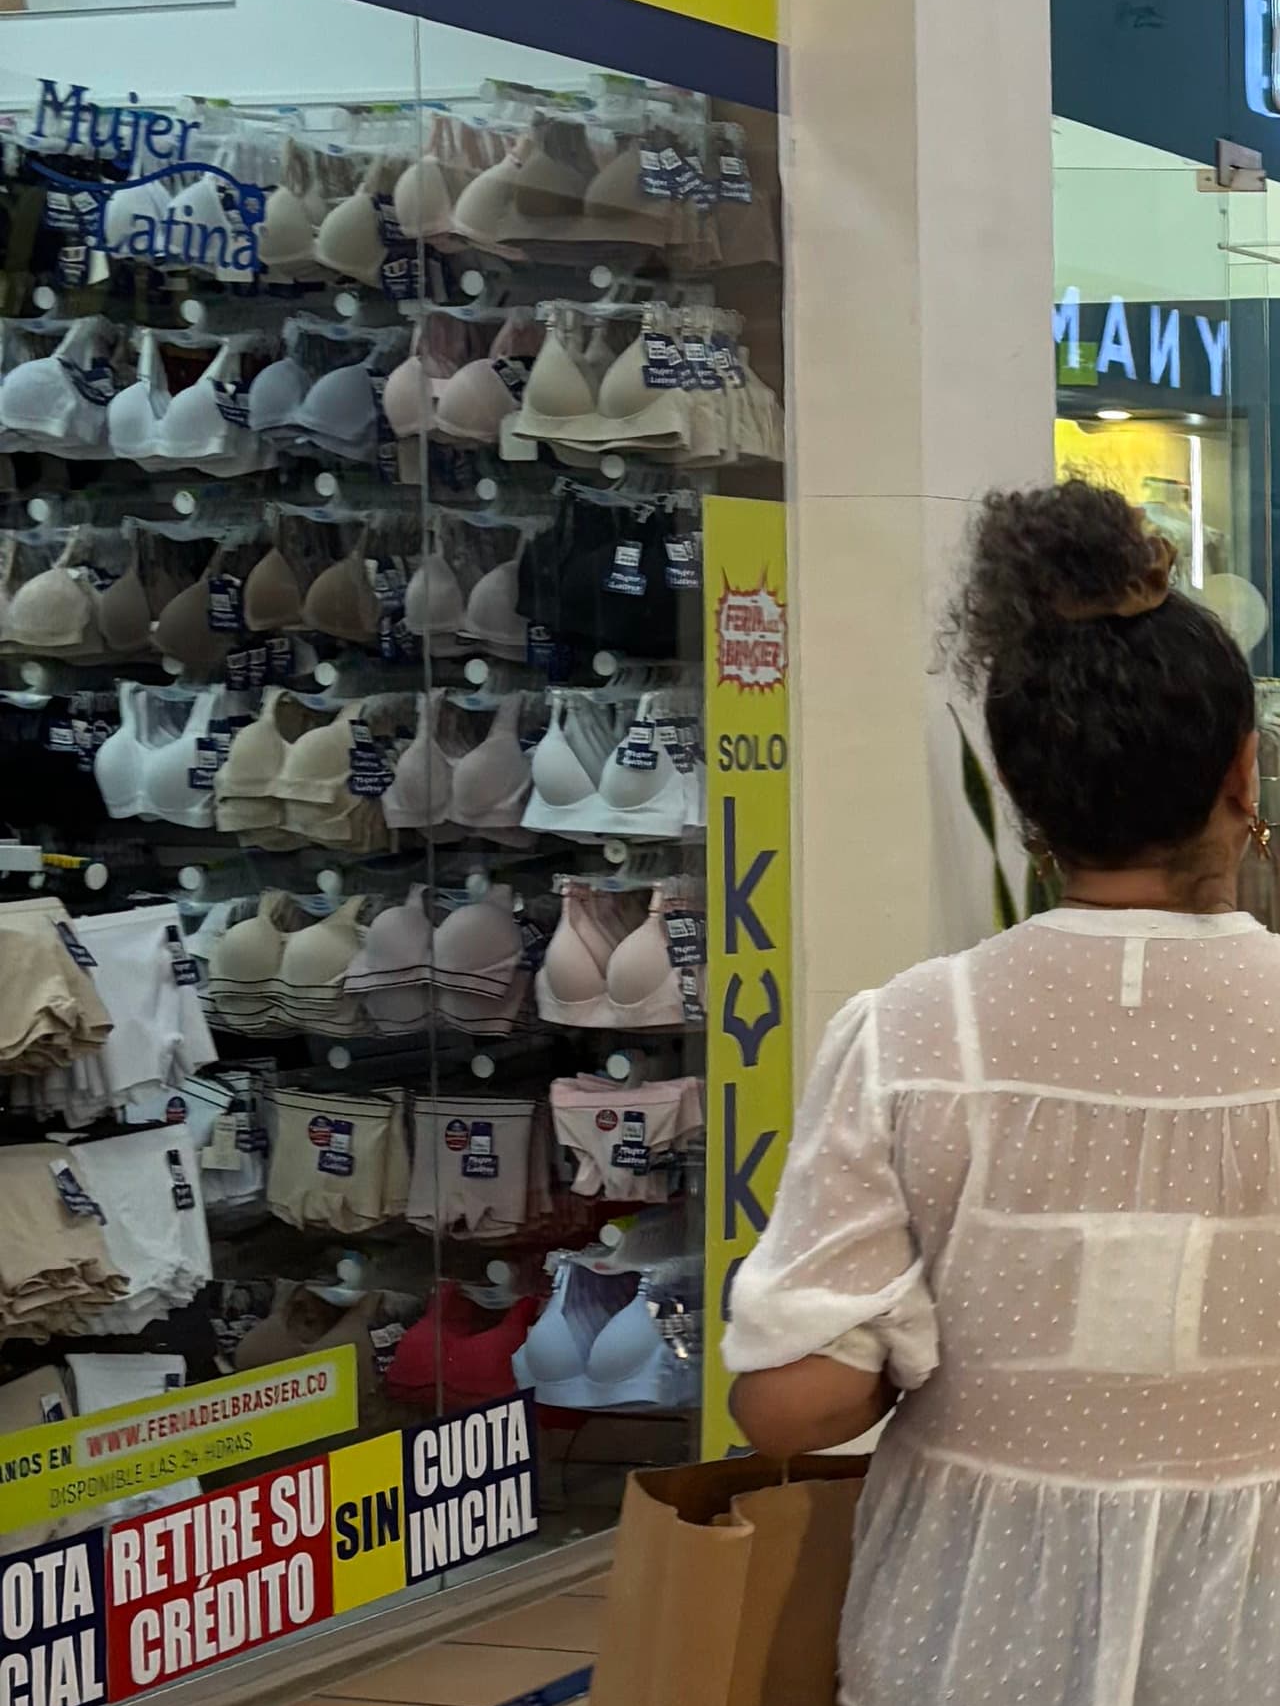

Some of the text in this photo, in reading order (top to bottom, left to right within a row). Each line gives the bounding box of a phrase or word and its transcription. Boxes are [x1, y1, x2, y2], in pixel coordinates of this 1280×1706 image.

[36, 78, 201, 171] Mujer
[89, 194, 268, 273] Latina
[718, 733, 787, 772] SOLO
[48, 1444, 73, 1470] EN
[50, 1463, 143, 1509] DISPONIBLE
[149, 1453, 177, 1479] LAS
[205, 1431, 254, 1463] HORAS
[413, 1399, 531, 1498] CUOTA
[111, 1463, 327, 1608] RETIRE SU
[335, 1485, 401, 1561] SIN
[409, 1472, 538, 1578] INICIAL
[129, 1552, 315, 1685] CRÉDITO
